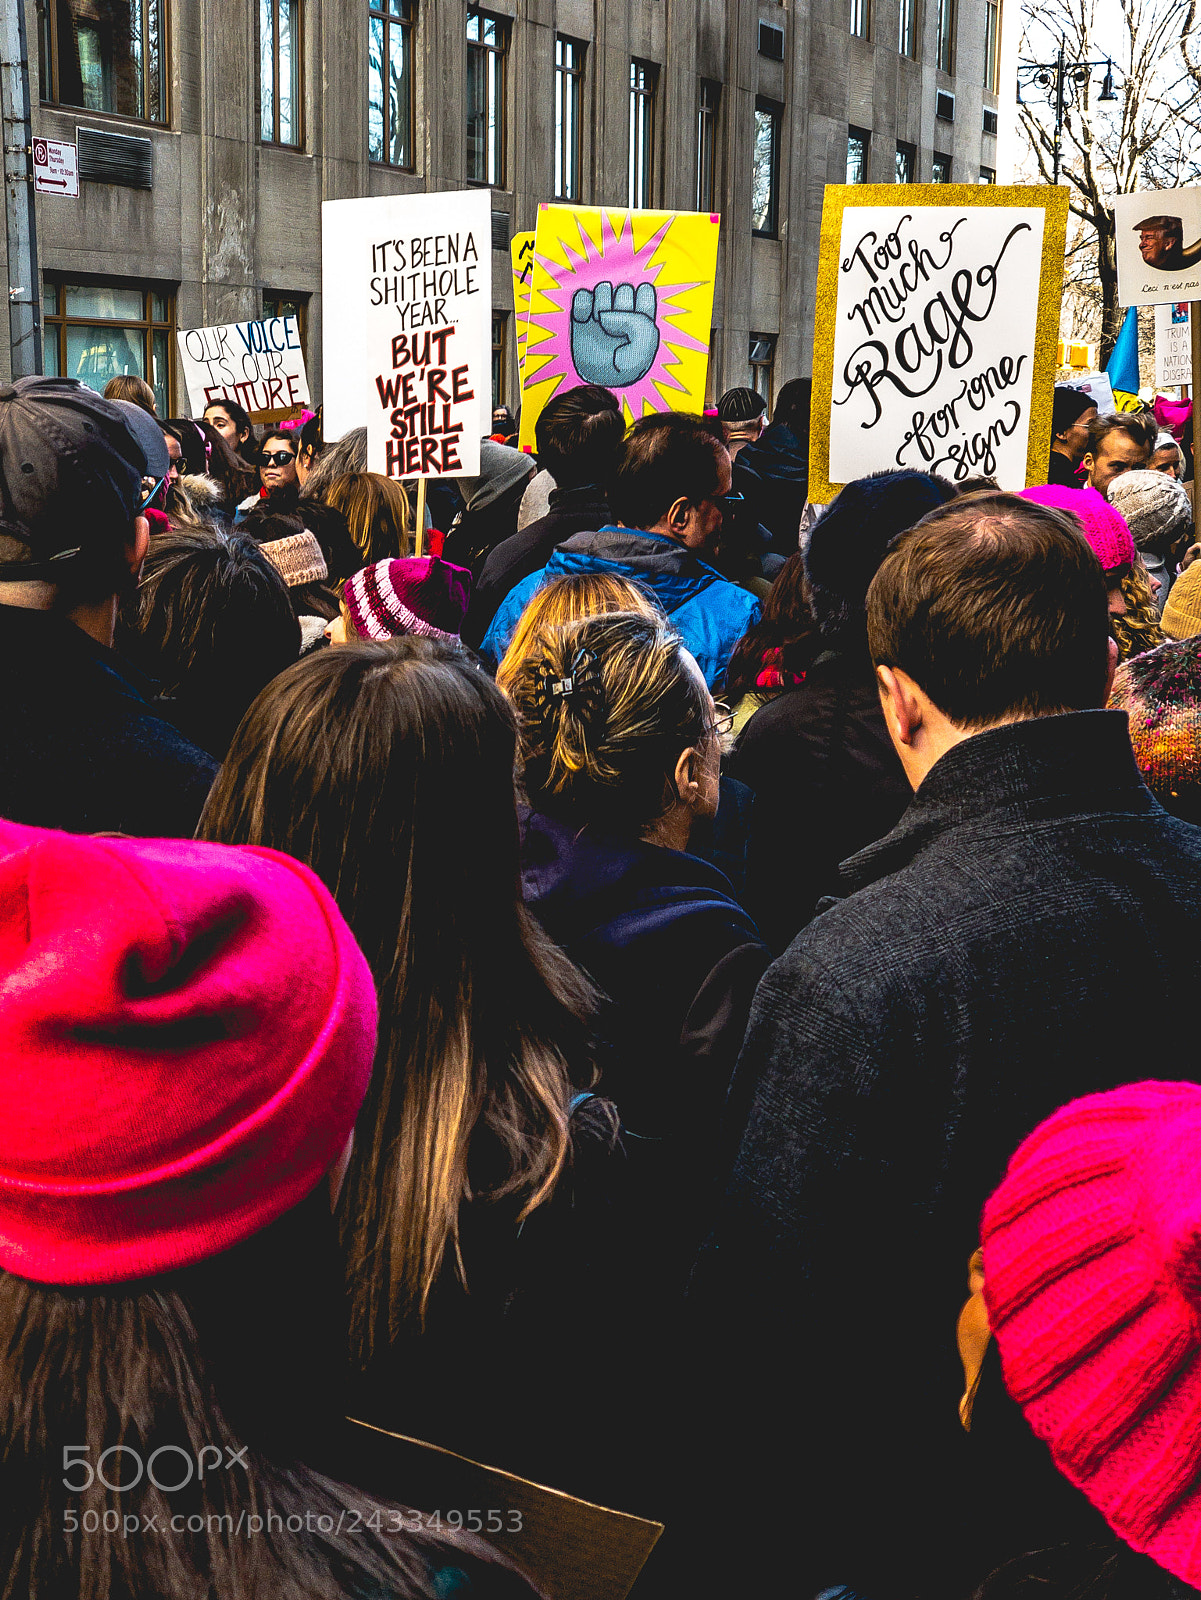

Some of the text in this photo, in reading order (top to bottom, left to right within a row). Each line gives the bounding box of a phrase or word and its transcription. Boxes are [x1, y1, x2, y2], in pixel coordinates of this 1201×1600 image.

[48, 148, 62, 156] Monday
[49, 155, 65, 165] Thursday
[372, 239, 407, 273] IT'S
[411, 233, 459, 269] BEEN
[463, 231, 479, 262] A
[840, 215, 912, 283] Too
[370, 265, 480, 306] SHITHOLE
[1142, 284, 1158, 293] Ceci
[1184, 281, 1200, 290] pas
[396, 298, 459, 331] YEAR...
[833, 223, 1031, 429] Rage
[1165, 326, 1190, 339] TRUM
[185, 315, 301, 363] OUR VOICE
[391, 326, 456, 370] BUT
[1170, 340, 1188, 353] IS A
[202, 350, 289, 388] IS OUR
[1162, 368, 1192, 382] DISGRA
[1163, 355, 1192, 367] NATION
[203, 374, 305, 412] FUTURE
[375, 364, 475, 410] WE'RE
[390, 401, 464, 440] STILL
[896, 354, 1028, 466] for one
[385, 434, 463, 477] HERE
[930, 400, 1021, 480] sign
